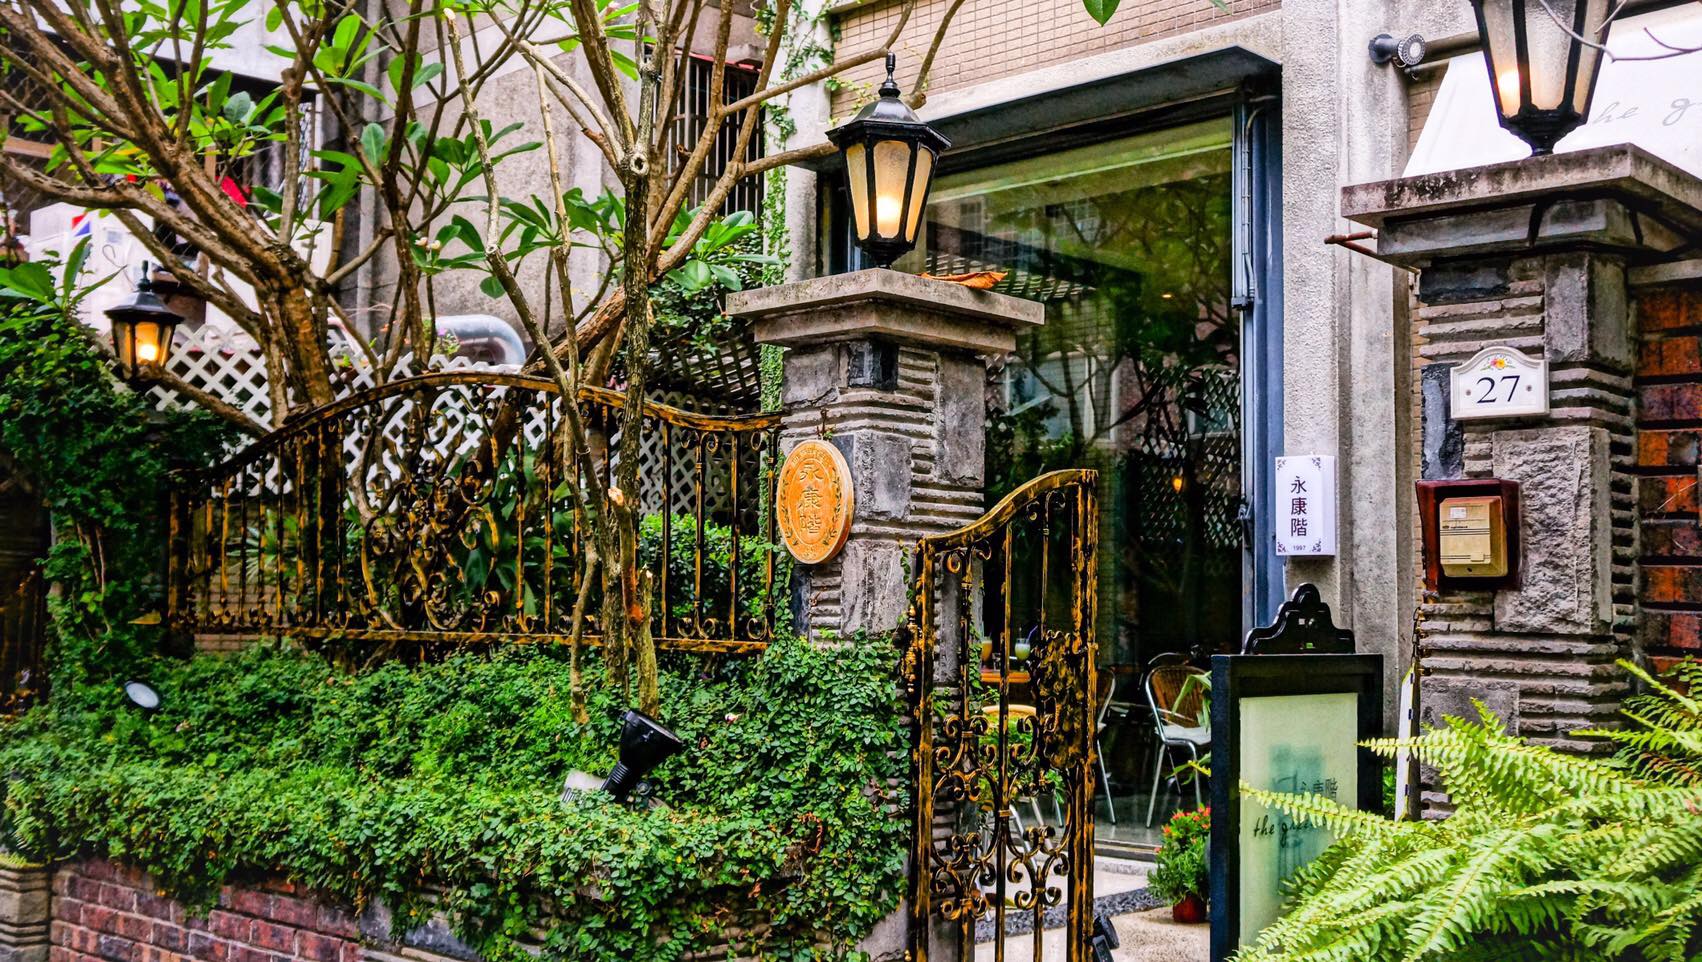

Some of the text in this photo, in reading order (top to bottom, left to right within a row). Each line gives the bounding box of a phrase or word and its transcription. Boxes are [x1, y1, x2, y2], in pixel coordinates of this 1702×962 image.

[1592, 98, 1695, 126] he g
[1476, 375, 1521, 404] 27
[798, 463, 823, 534] 永康階
[1290, 475, 1308, 537] 永康階
[1253, 815, 1275, 837] the
